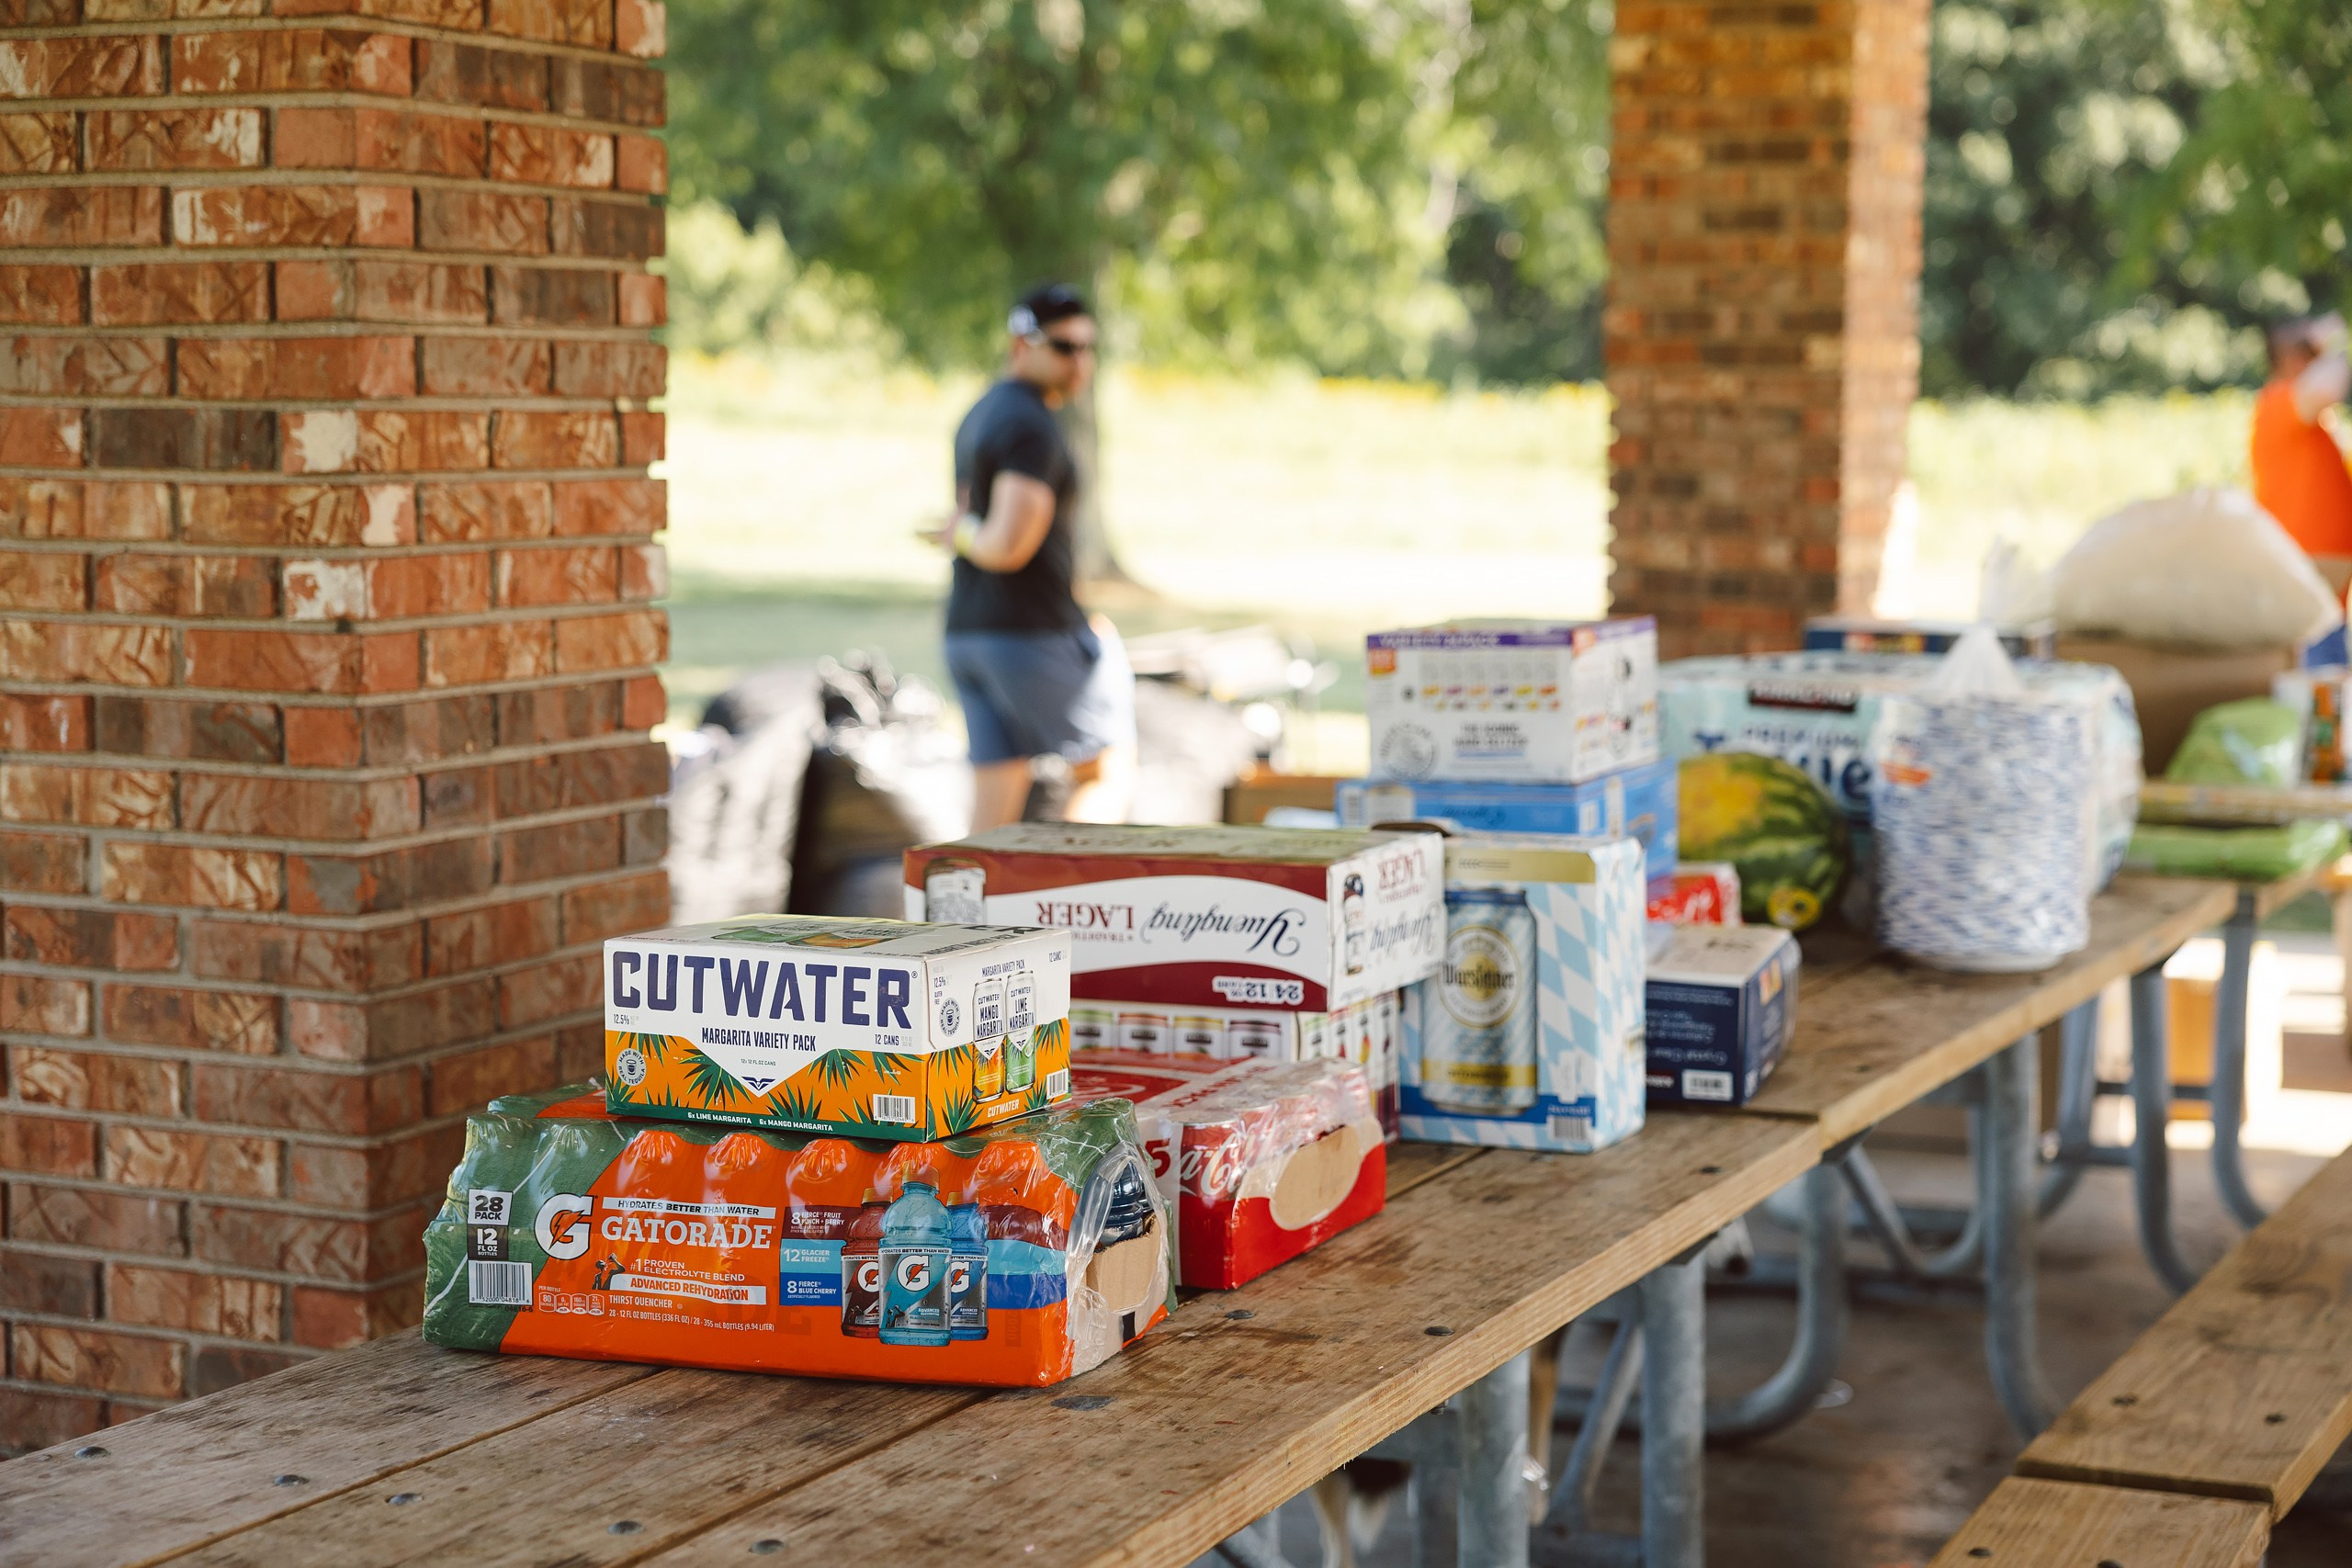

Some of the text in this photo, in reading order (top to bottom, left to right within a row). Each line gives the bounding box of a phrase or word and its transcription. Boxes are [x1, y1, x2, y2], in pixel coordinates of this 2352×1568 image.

[1036, 900, 1134, 930] LAGER
[1140, 901, 1307, 957] Yuengling
[981, 964, 1001, 977] MARGARITA
[613, 951, 912, 1030] CUTWATER
[1246, 983, 1266, 998] 12
[1275, 984, 1299, 1000] 24
[980, 1004, 999, 1022] MANGO
[1015, 997, 1027, 1014] LIME
[614, 1014, 630, 1025] 12.5%
[1009, 1011, 1035, 1031] MARGARITA
[977, 1020, 1003, 1039] MARGARITA
[702, 1027, 817, 1052] MARGARITA VARIETY PACK
[875, 1034, 881, 1044] 12
[883, 1034, 899, 1046] CANS
[618, 1050, 645, 1065] MADE WITH
[987, 1099, 1020, 1118] CUTWATER
[695, 1112, 712, 1121] LIME
[712, 1113, 752, 1124] MARGARITA
[767, 1119, 792, 1128] MANGO
[793, 1122, 833, 1132] MARGARITA
[475, 1195, 503, 1212] 28
[617, 1200, 760, 1216] HYDRATES BETTER THAN WATER
[474, 1212, 502, 1220] PACK
[791, 1212, 800, 1224] 8
[534, 1192, 594, 1261] G
[601, 1215, 773, 1249] GATORADE
[477, 1227, 498, 1245] 12
[784, 1249, 800, 1262] 12
[629, 1258, 685, 1272] #1 PROVEN
[644, 1266, 745, 1281] ELECTROLYTE BLEND
[897, 1255, 931, 1292] G
[630, 1277, 749, 1301] ADVANCED REHYDRATION
[786, 1280, 797, 1293] 8
[609, 1294, 673, 1309] THIRST QUENCHER
[608, 1309, 616, 1317] 28
[619, 1310, 626, 1318] 12
[632, 1311, 639, 1319] OZ
[640, 1312, 662, 1321] BOTTLES
[662, 1313, 674, 1323] (336
[674, 1314, 680, 1323] FL
[693, 1317, 700, 1325] 28
[704, 1318, 713, 1327] 355
[723, 1322, 743, 1331] BOTTLES
